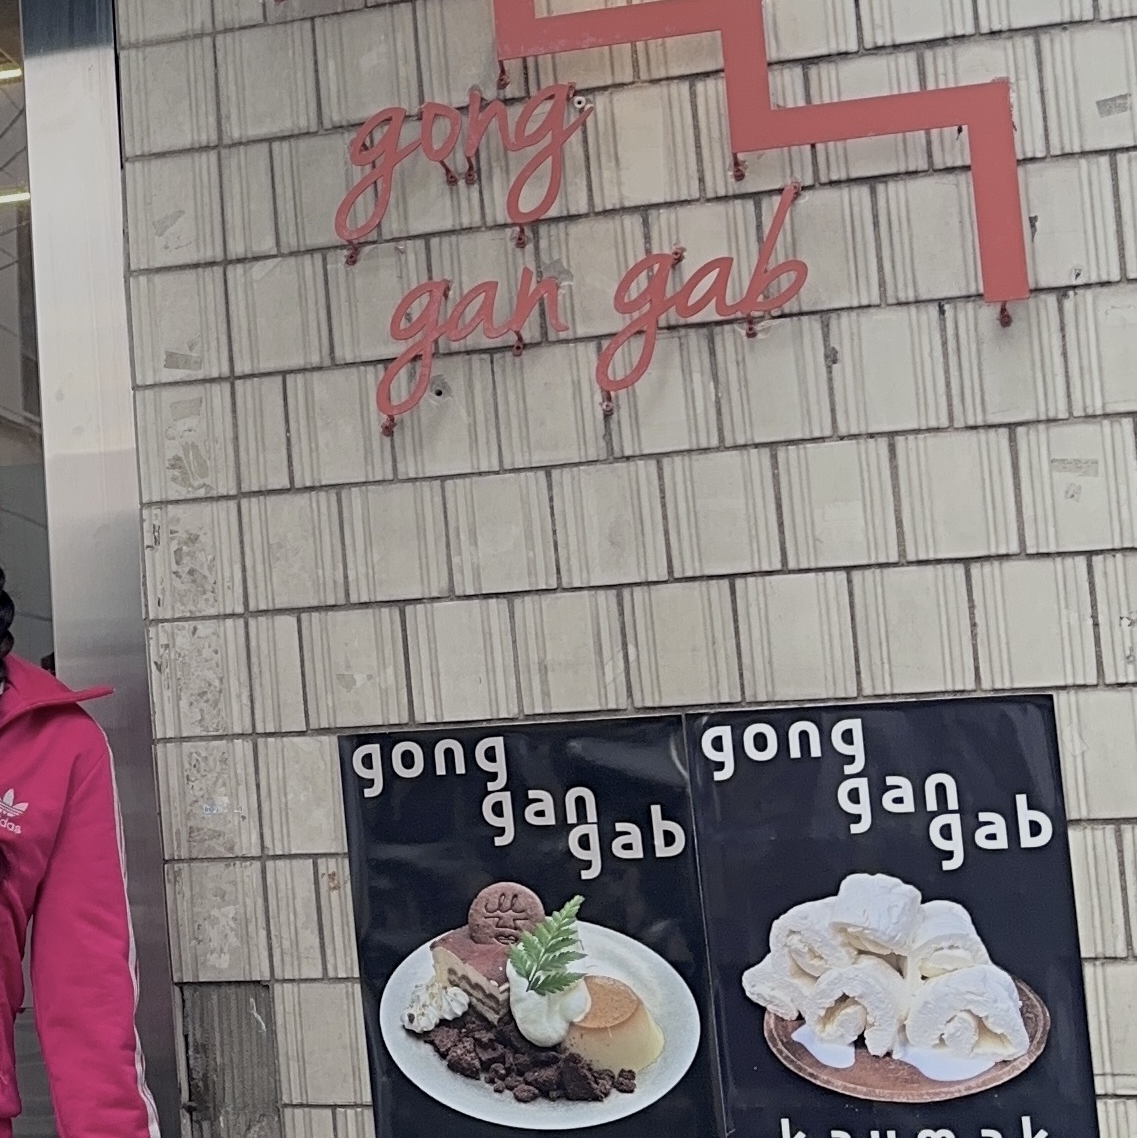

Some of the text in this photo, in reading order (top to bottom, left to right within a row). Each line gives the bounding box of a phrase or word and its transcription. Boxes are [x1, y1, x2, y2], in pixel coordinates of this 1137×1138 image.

[334, 82, 594, 241] gong
[376, 182, 808, 416] gan gab
[352, 737, 507, 798] gong
[700, 717, 865, 781] gong
[482, 786, 598, 846] gan
[838, 772, 958, 833] gan
[929, 794, 1053, 871] gab
[569, 804, 686, 880] gab
